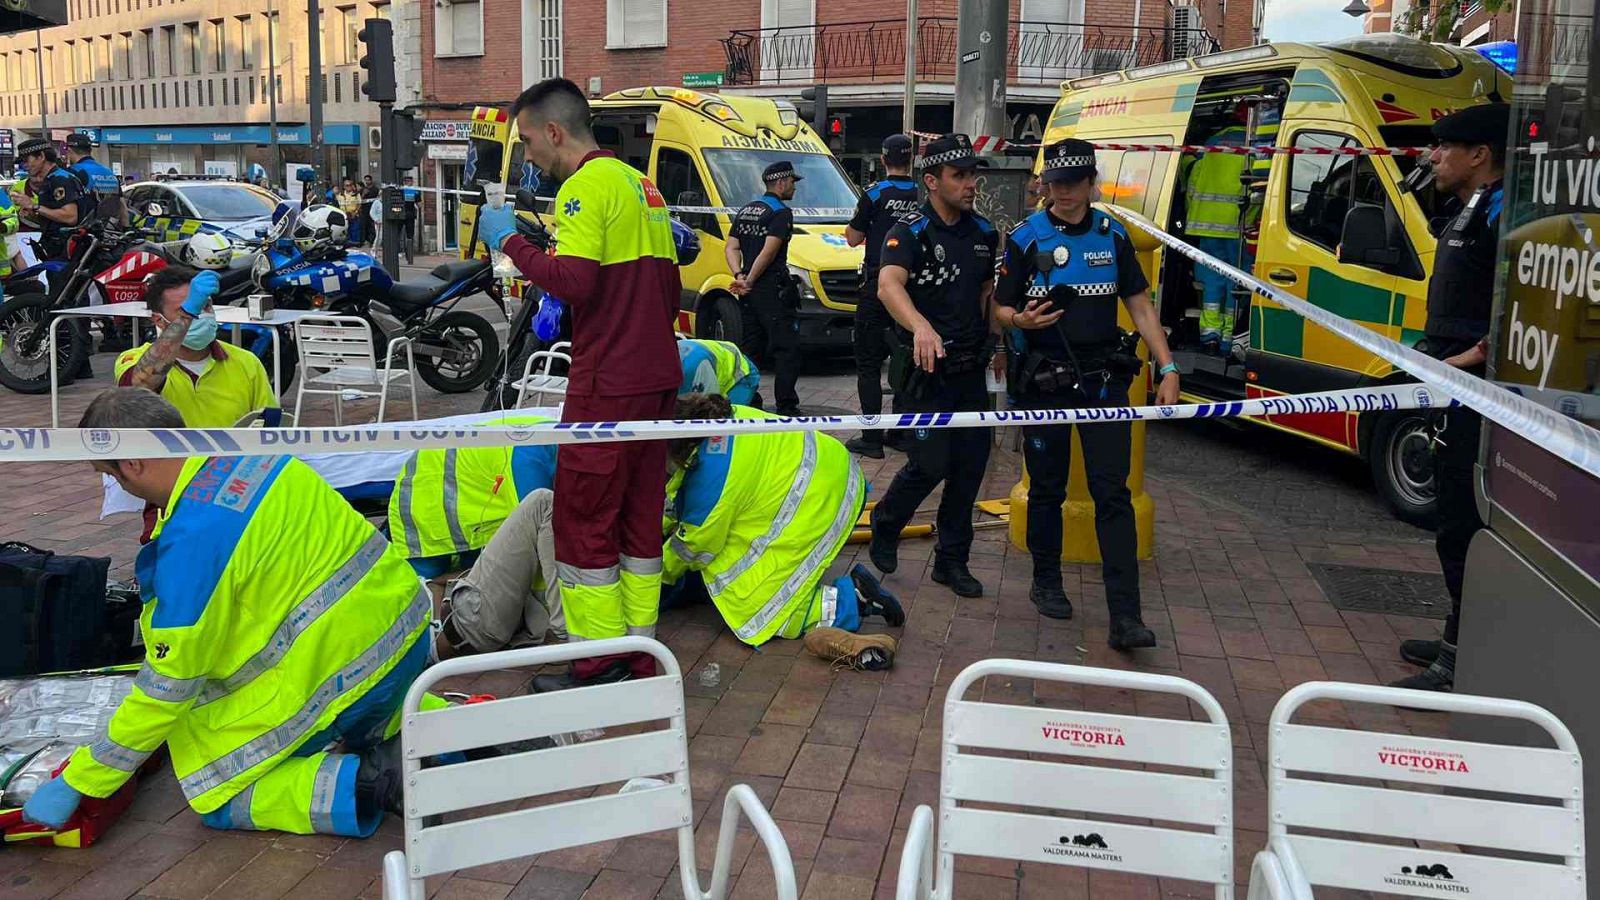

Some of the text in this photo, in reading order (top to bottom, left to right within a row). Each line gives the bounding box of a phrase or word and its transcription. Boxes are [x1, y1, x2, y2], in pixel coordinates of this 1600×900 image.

[471, 122, 496, 138] ANCIA
[1529, 141, 1559, 205] Tu
[885, 199, 918, 211] POLIC
[119, 291, 139, 301] 092
[1507, 300, 1559, 391] hoy
[1262, 395, 1338, 415] POLICIA
[1042, 727, 1126, 746] VICTORIA
[1378, 752, 1469, 773] VICTORIA
[1043, 847, 1123, 862] VALDERRAMA MASTERS
[1384, 876, 1470, 894] VALDERRAMA MASTERS
